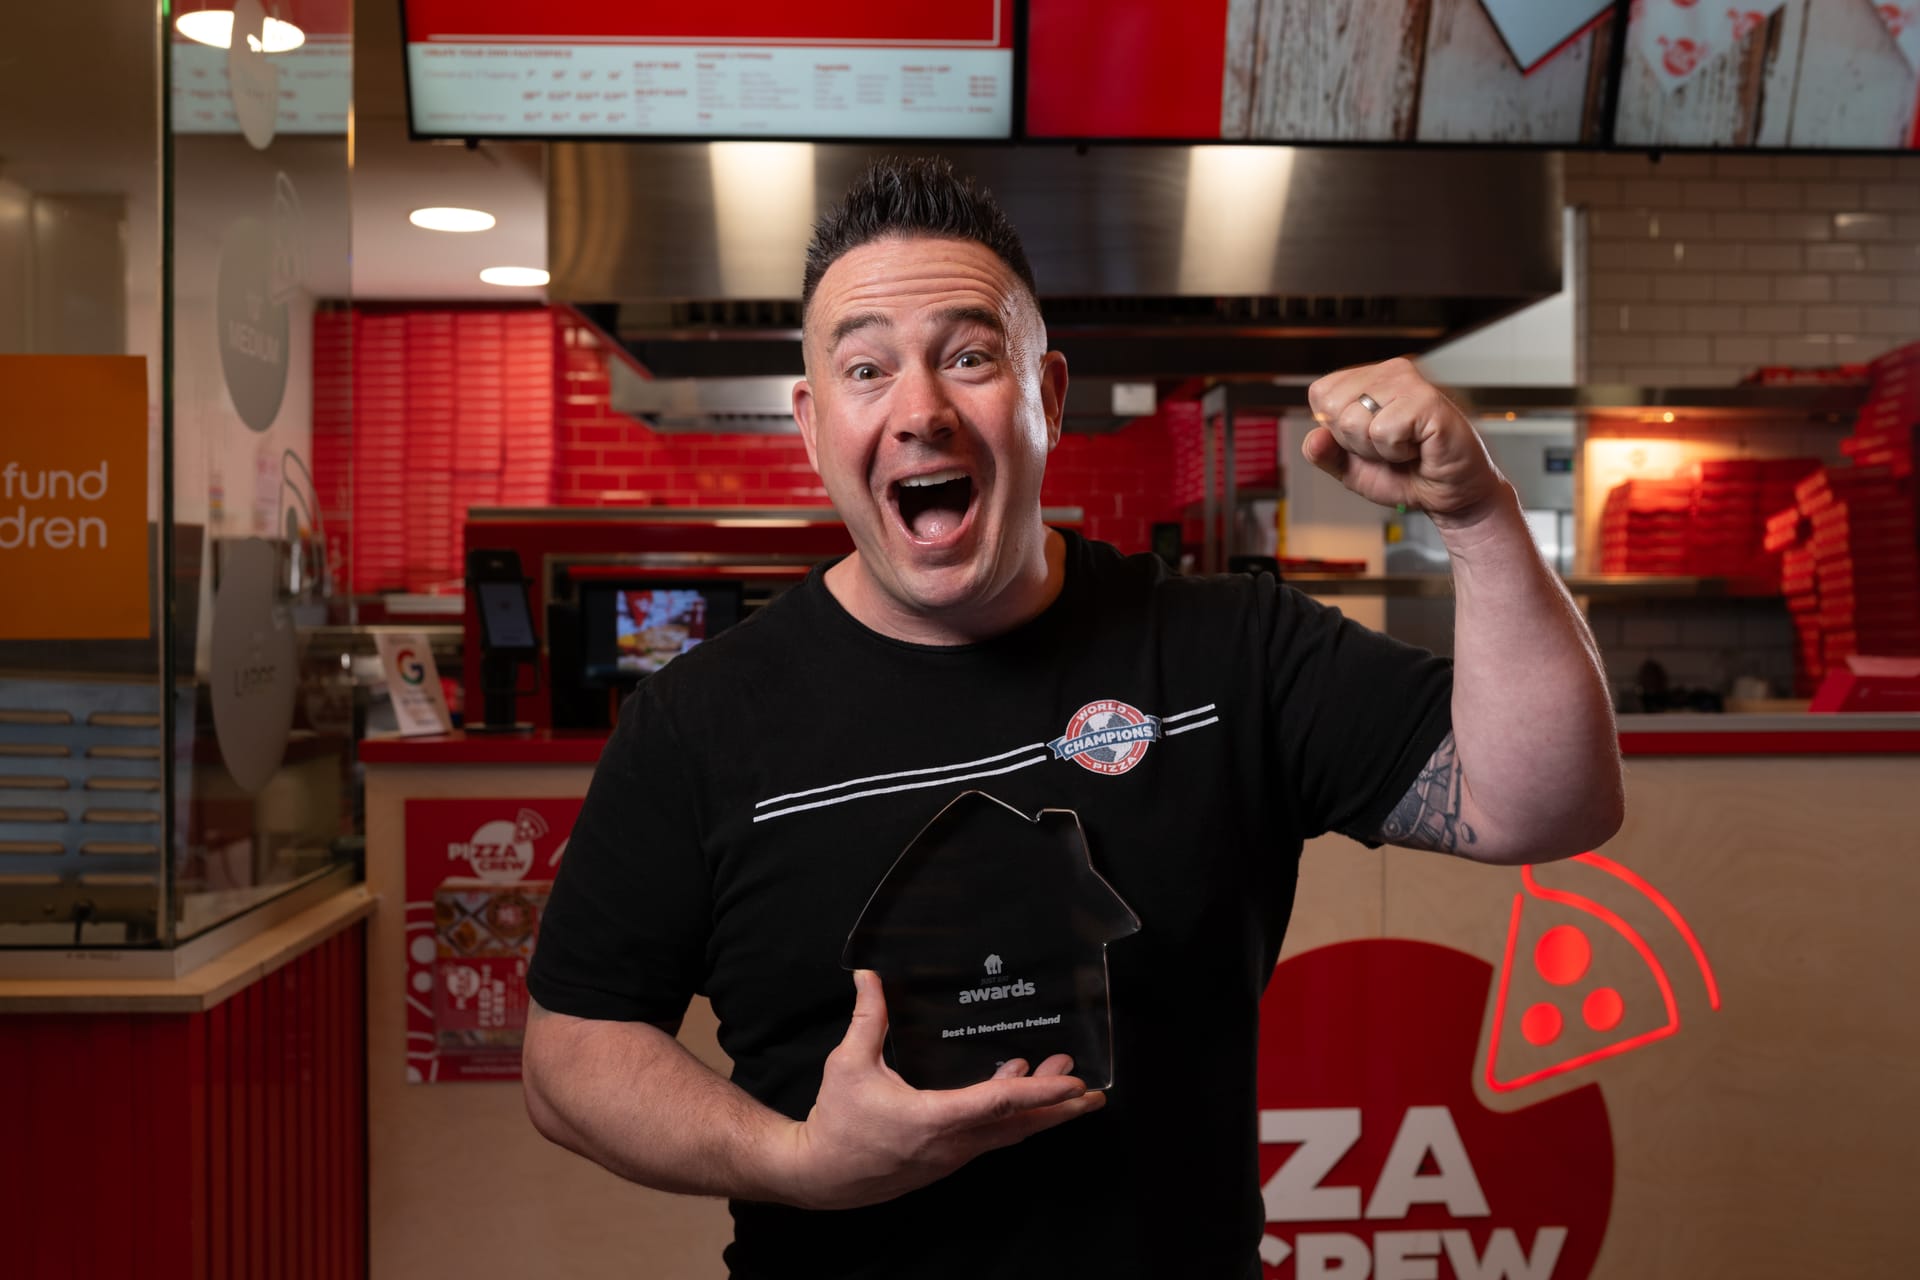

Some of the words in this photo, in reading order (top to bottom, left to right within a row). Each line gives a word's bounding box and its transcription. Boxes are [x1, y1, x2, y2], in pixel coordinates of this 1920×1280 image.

[2, 460, 108, 499] fund
[0, 506, 107, 549] dren
[1077, 703, 1127, 721] WORLD
[1064, 726, 1154, 755] CHAMPIONS
[1092, 756, 1138, 773] PIZZA
[448, 843, 519, 861] PIZZA
[478, 859, 526, 872] CREW
[959, 979, 1036, 1004] awards
[942, 1029, 965, 1038] Best
[978, 1020, 1024, 1034] Northern
[1026, 1014, 1061, 1028] Ireland
